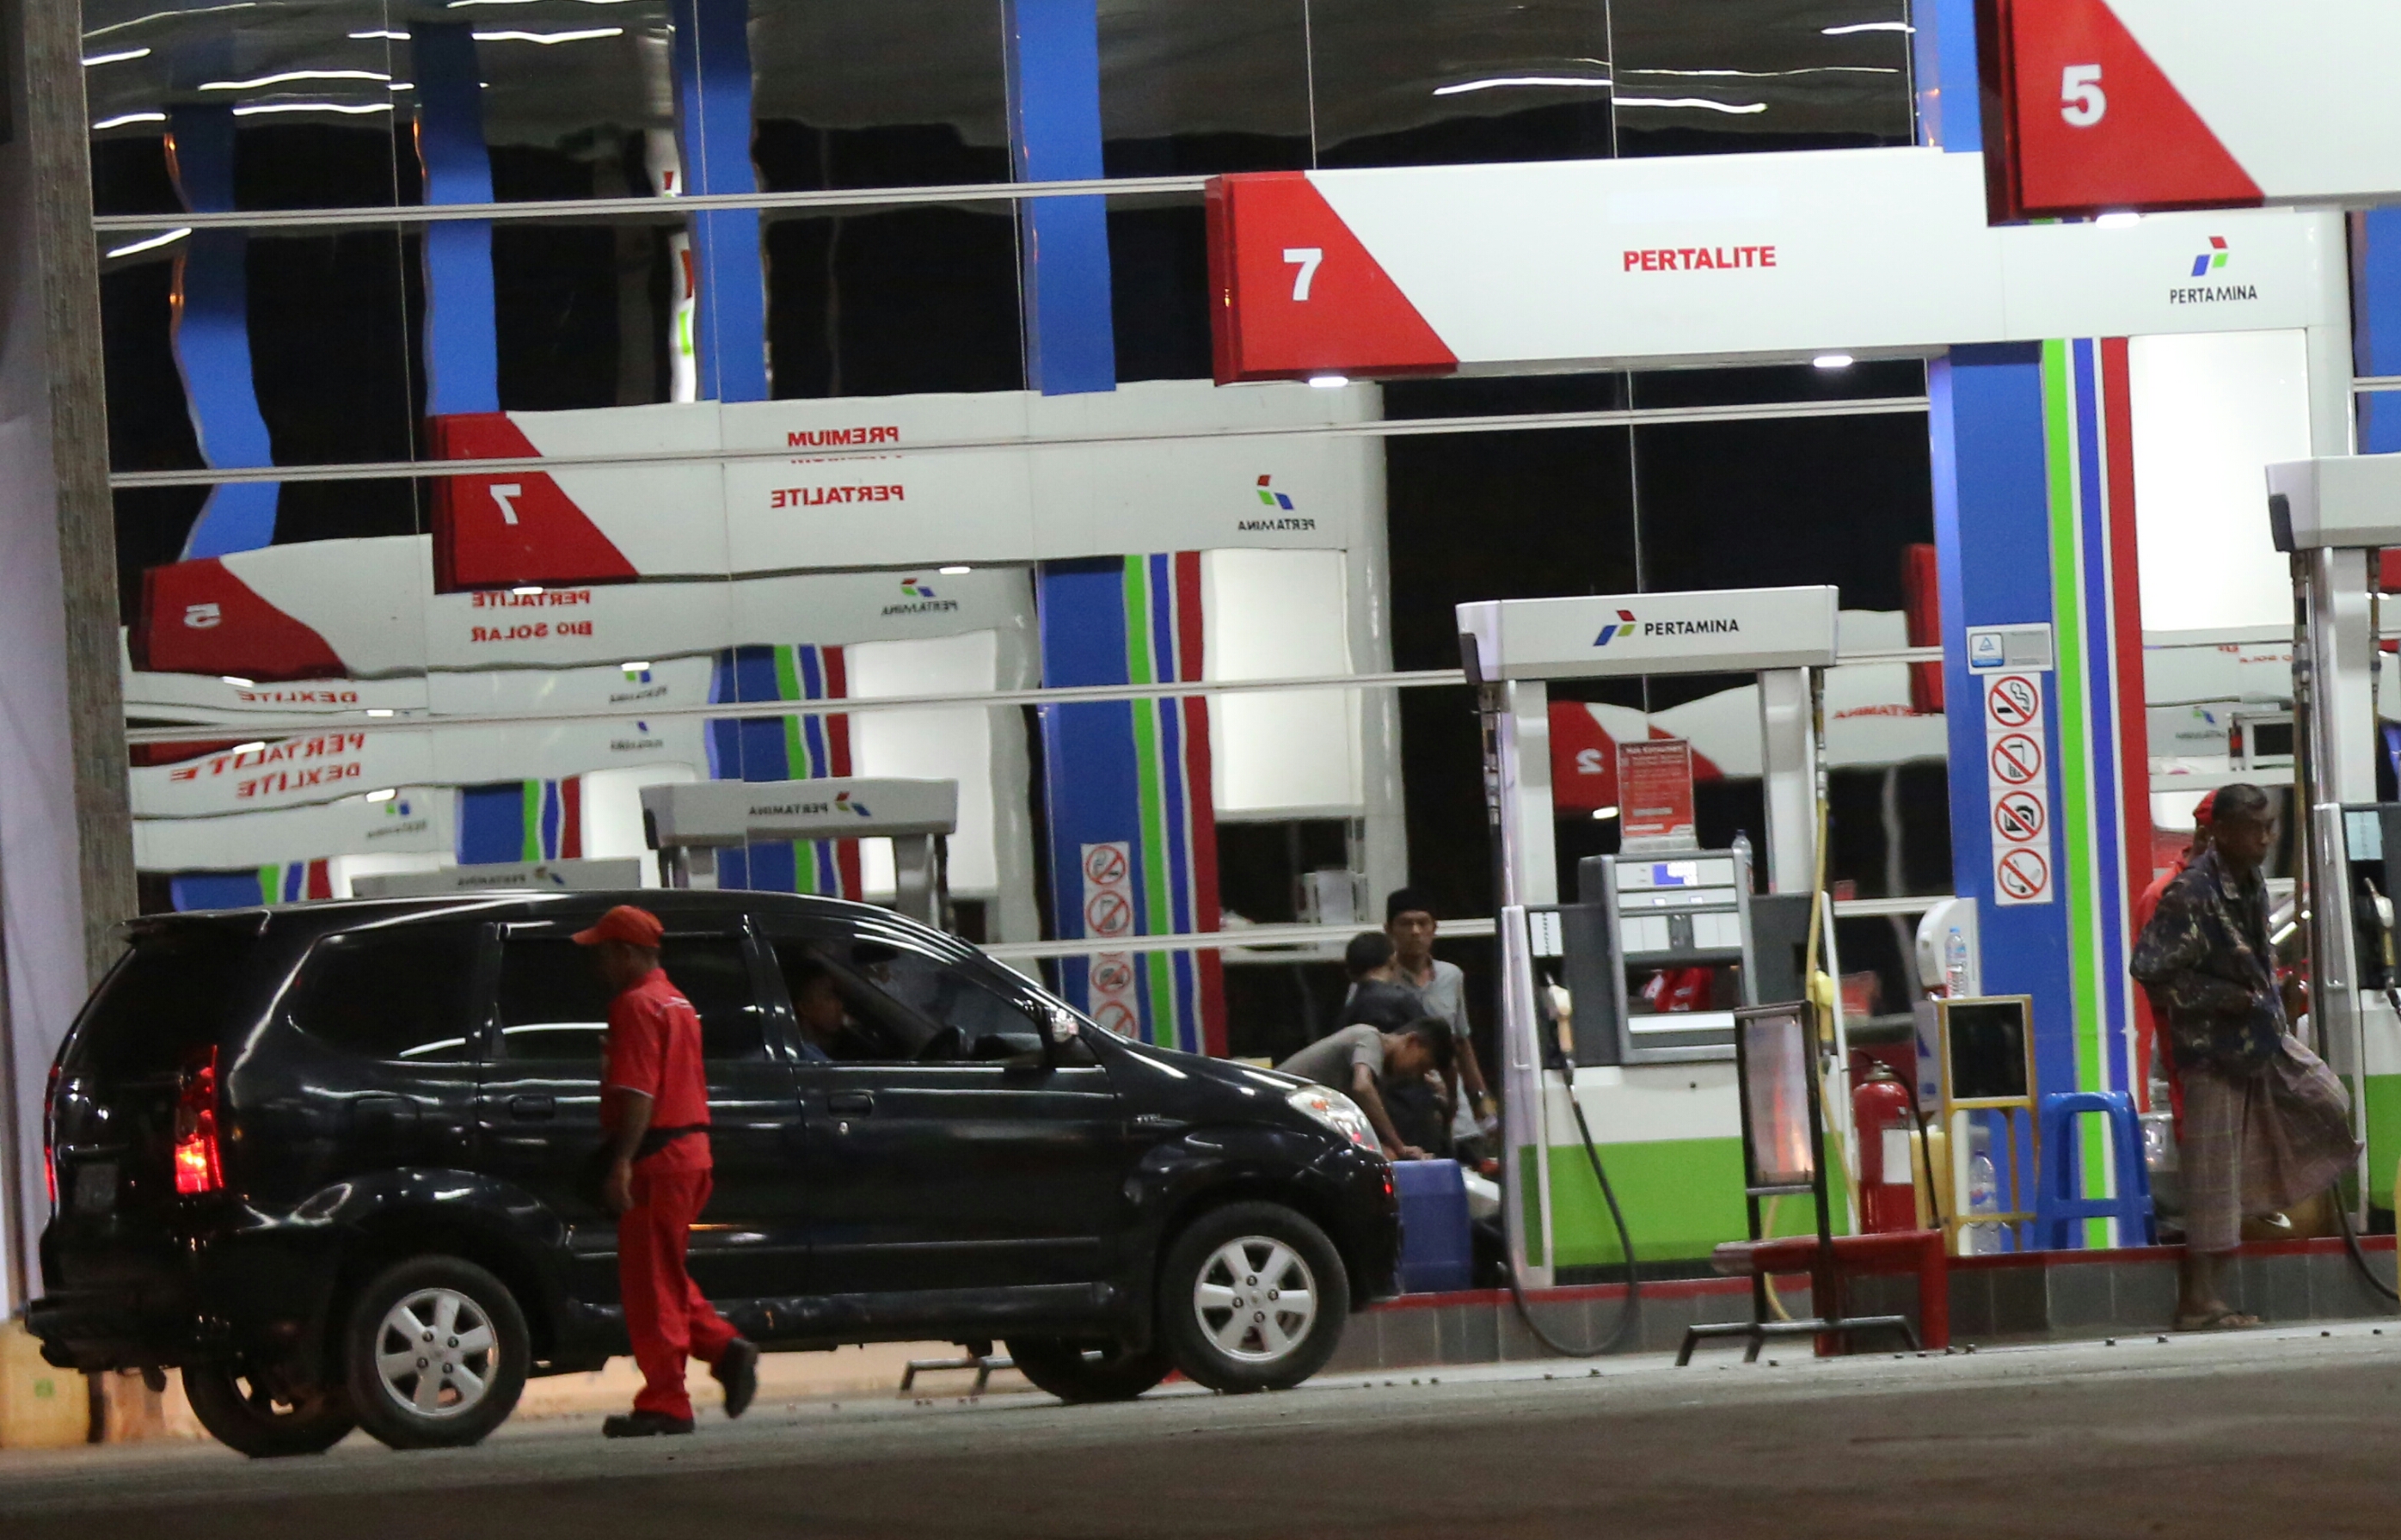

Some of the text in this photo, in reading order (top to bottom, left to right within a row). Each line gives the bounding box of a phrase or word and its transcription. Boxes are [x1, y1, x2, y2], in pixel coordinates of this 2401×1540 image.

[2060, 64, 2107, 127] 5
[1623, 245, 1777, 273] PERTALITE
[1282, 247, 1323, 302] 7
[2169, 284, 2259, 304] PERTAMINA
[1644, 618, 1741, 637] PERTAMINA
